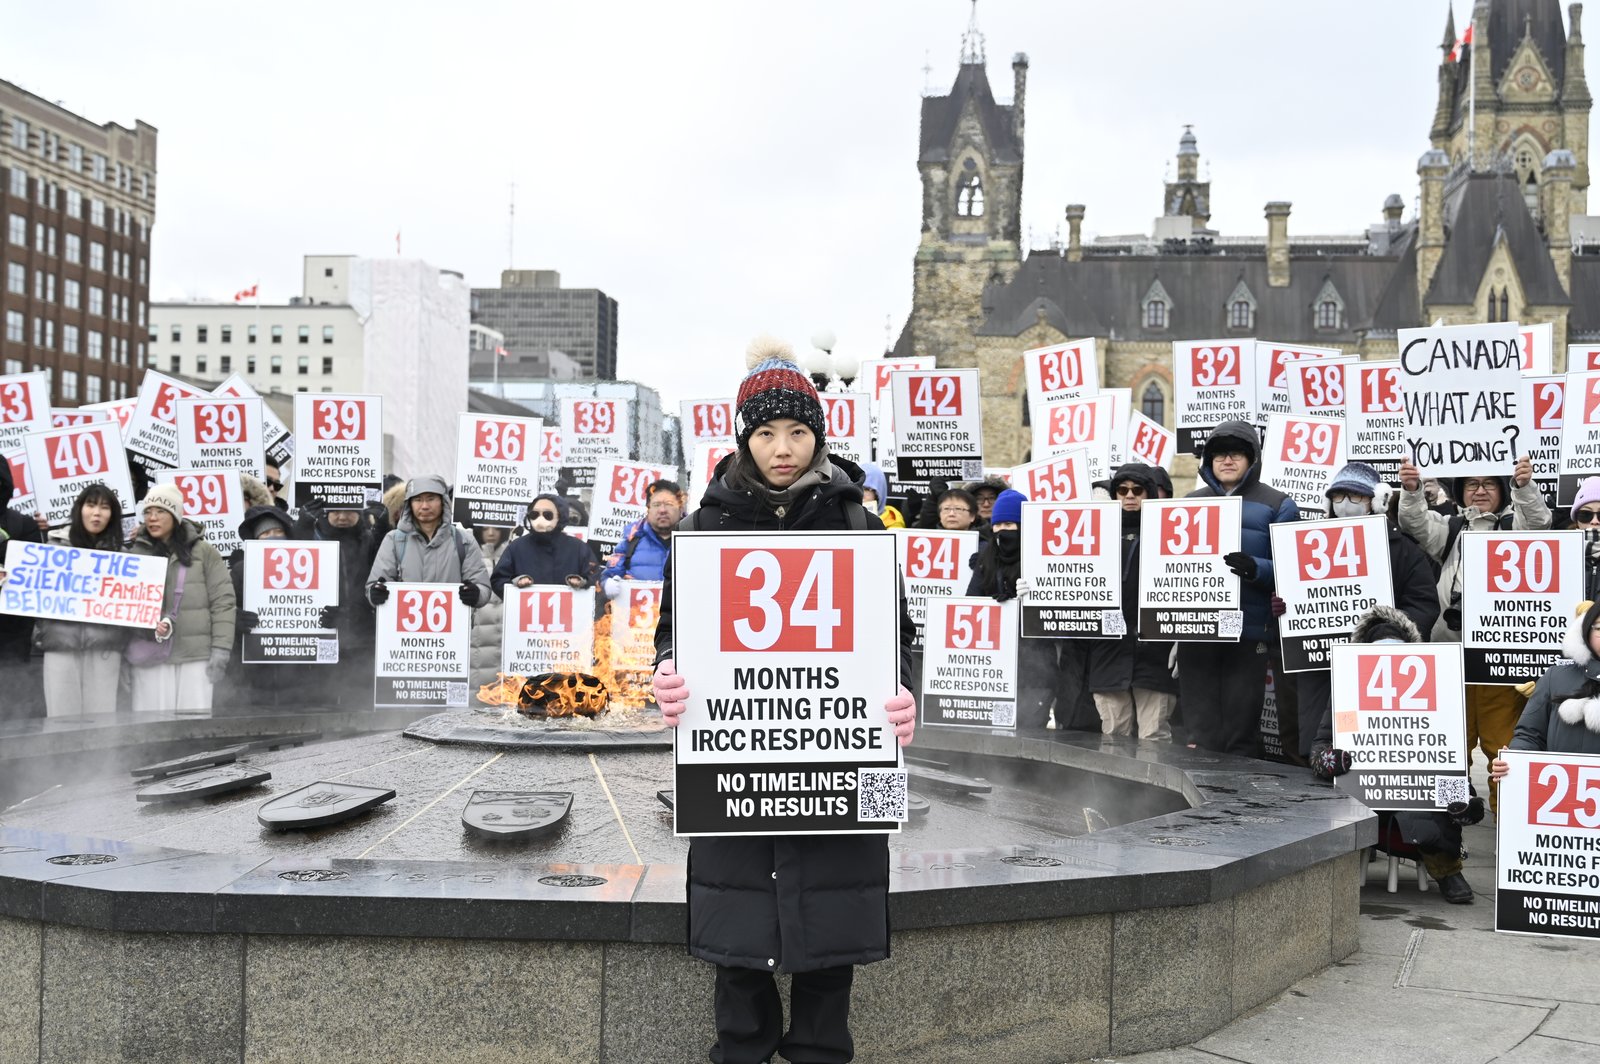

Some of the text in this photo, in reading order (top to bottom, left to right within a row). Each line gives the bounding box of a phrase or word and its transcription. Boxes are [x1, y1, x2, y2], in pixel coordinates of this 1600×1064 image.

[1401, 338, 1520, 375] CANADA
[1044, 350, 1078, 390] 30
[1197, 347, 1236, 387] 32
[1305, 365, 1344, 406] 38
[1366, 368, 1402, 412] 13
[915, 377, 957, 416] 42
[1197, 390, 1235, 399] MONTHS
[1187, 400, 1245, 411] WAITING FOR
[1403, 391, 1516, 426] WHAT ARE
[319, 401, 360, 440] 39
[578, 402, 612, 433] 39
[698, 404, 726, 436] 19
[1181, 411, 1250, 423] IRCC RESPONSE
[201, 405, 241, 443] 39
[916, 420, 957, 429] MONTHS
[1052, 404, 1091, 444] 30
[1366, 418, 1404, 429] MONTHS
[139, 429, 174, 448] WAITING
[480, 422, 520, 460] 36
[906, 432, 969, 440] WAITING FOR
[1357, 431, 1395, 442] WAITING
[130, 437, 151, 452] IRCC
[901, 443, 975, 452] IRCC RESPONSE
[1136, 424, 1161, 462] 31
[1288, 423, 1332, 464] 39
[1407, 425, 1520, 467] YOU DOING?
[54, 432, 101, 477] 40
[202, 447, 242, 457] MONTHS
[318, 445, 359, 454] MONTHS
[1352, 445, 1371, 455] IRCC
[192, 458, 253, 468] WAITING FOR
[307, 457, 370, 466] WAITING FOR
[301, 468, 375, 478] IRCC RESPONSE
[478, 463, 517, 474] MONTHS
[1284, 467, 1327, 479] MONTHS
[467, 474, 527, 486] WAITING FOR
[1033, 459, 1071, 499] 55
[1271, 479, 1314, 491] WAITING
[181, 475, 224, 515] 39
[311, 485, 322, 493] NO
[460, 484, 532, 498] IRCC RESPONSE
[327, 495, 362, 503] RESULTS
[469, 501, 479, 509] NO
[471, 511, 482, 519] NO
[1048, 510, 1095, 555] 34
[1167, 507, 1212, 555] 31
[912, 537, 954, 579] 34
[1304, 527, 1360, 580] 34
[21, 544, 141, 577] STOP THE
[1494, 541, 1552, 592] 30
[270, 549, 314, 589] 39
[1048, 562, 1093, 573] MONTHS
[1166, 562, 1211, 572] MONTHS
[1035, 576, 1106, 587] WAITING FOR
[1153, 576, 1223, 587] WAITING FOR
[911, 583, 952, 594] MONTHS
[1307, 583, 1362, 598] MONTHS
[269, 594, 312, 603] MONTHS
[733, 550, 841, 650] 34
[1029, 590, 1112, 601] IRCC RESPONSE
[1146, 591, 1229, 602] IRCC RESPONSE
[258, 607, 300, 616] WAITING
[1295, 600, 1348, 615] WAITING
[1494, 599, 1551, 612] MONTHS
[403, 592, 446, 633] 36
[527, 593, 565, 632] 11
[1040, 610, 1101, 620] NO TIMELINES
[1157, 612, 1218, 622] NO TIMELINES
[1044, 621, 1097, 631] NO RESULTS
[1288, 618, 1316, 630] IRCC
[1480, 615, 1567, 627] WAITING FOR
[952, 606, 994, 650] 51
[1161, 624, 1214, 634] NO RESULTS
[261, 637, 272, 645] NO
[1472, 630, 1500, 642] IRCC
[402, 638, 445, 648] MONTHS
[526, 638, 566, 647] MONTHS
[1303, 639, 1317, 649] NO
[265, 647, 315, 656] NO RESULTS
[390, 651, 456, 660] WAITING FOR
[515, 650, 577, 659] WAITING FOR
[1308, 651, 1323, 661] NO
[949, 654, 992, 665] MONTHS
[1485, 653, 1500, 663] NO
[383, 663, 462, 672] IRCC RESPONSE
[937, 667, 1003, 678] WAITING FOR
[1490, 666, 1505, 676] NO
[735, 667, 839, 689] MONTHS
[1367, 657, 1428, 711] 42
[930, 679, 1008, 692] IRCC RESPONSE
[397, 691, 447, 699] NO RESULTS
[939, 698, 951, 707] NO
[707, 698, 867, 720] WAITING FOR
[942, 709, 954, 718] NO
[1367, 719, 1429, 731] MONTHS
[691, 728, 881, 751] IRCC RESPONSE
[1351, 736, 1446, 747] WAITING FOR
[1378, 752, 1455, 764] RESPONSE
[717, 772, 857, 792] NO TIMELINES
[1359, 776, 1375, 786] NO
[1365, 789, 1381, 800] NO
[1536, 764, 1600, 828] 25
[726, 797, 848, 818] NO RESULTS
[1518, 851, 1585, 869] WAITING
[1508, 868, 1542, 884] IRCC
[1524, 896, 1541, 909] NO
[1529, 912, 1547, 925] NO
